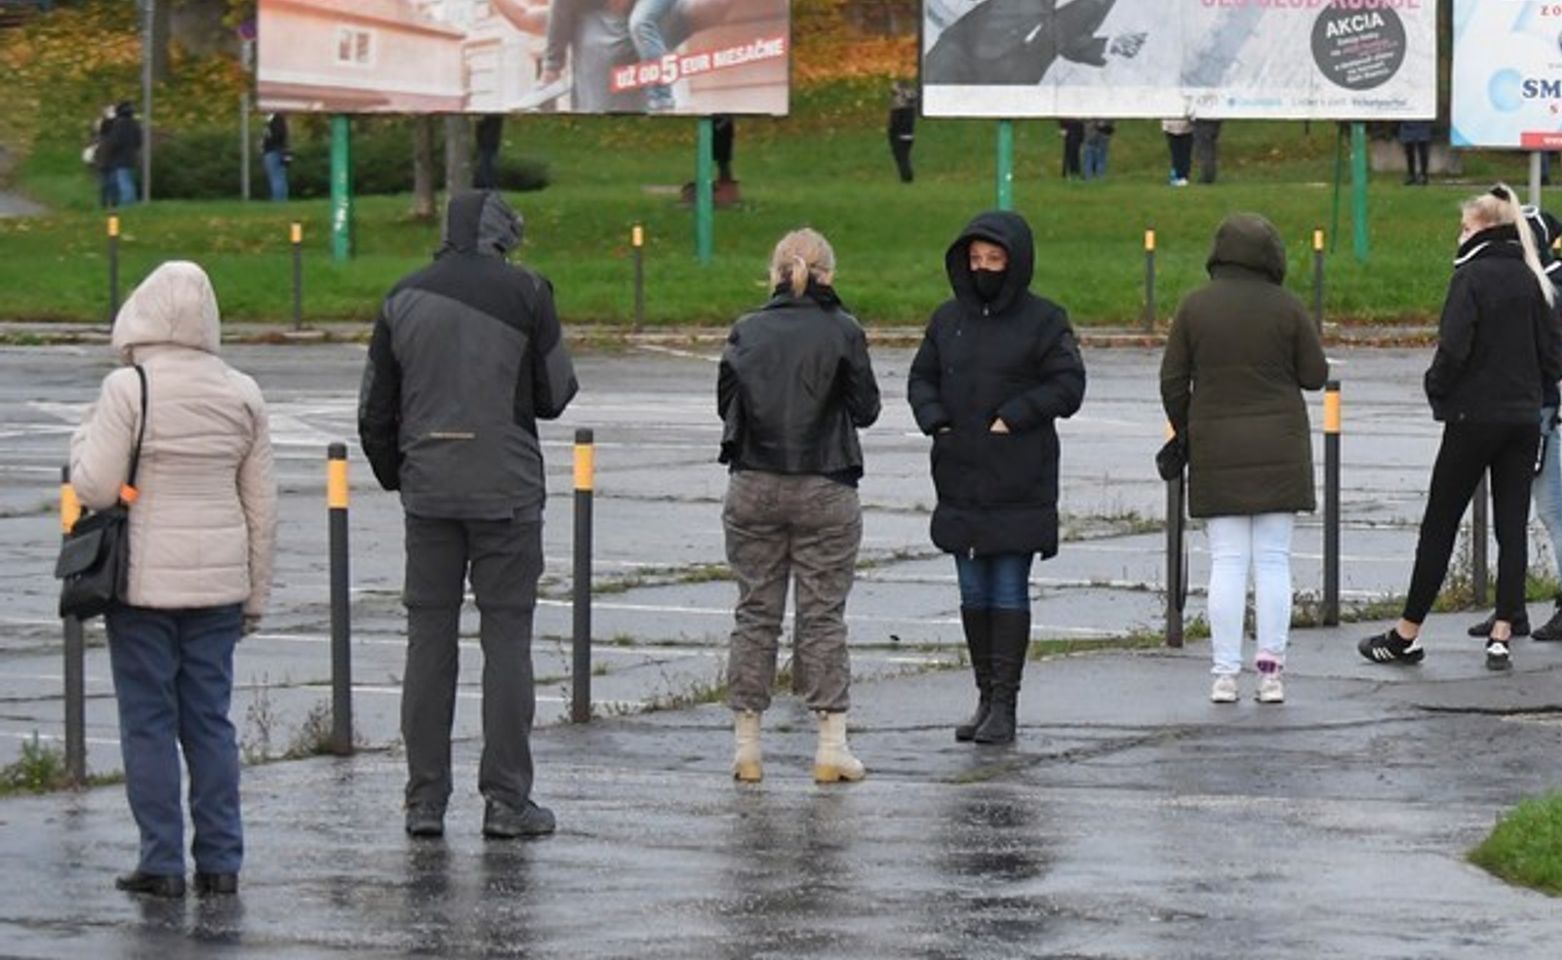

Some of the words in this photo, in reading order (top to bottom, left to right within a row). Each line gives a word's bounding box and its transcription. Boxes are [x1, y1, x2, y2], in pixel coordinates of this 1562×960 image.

[1541, 5, 1550, 16] Z
[1326, 11, 1385, 39] AKCIA
[661, 55, 678, 83] 5
[680, 54, 711, 75] EUR
[1550, 104, 1558, 114] S
